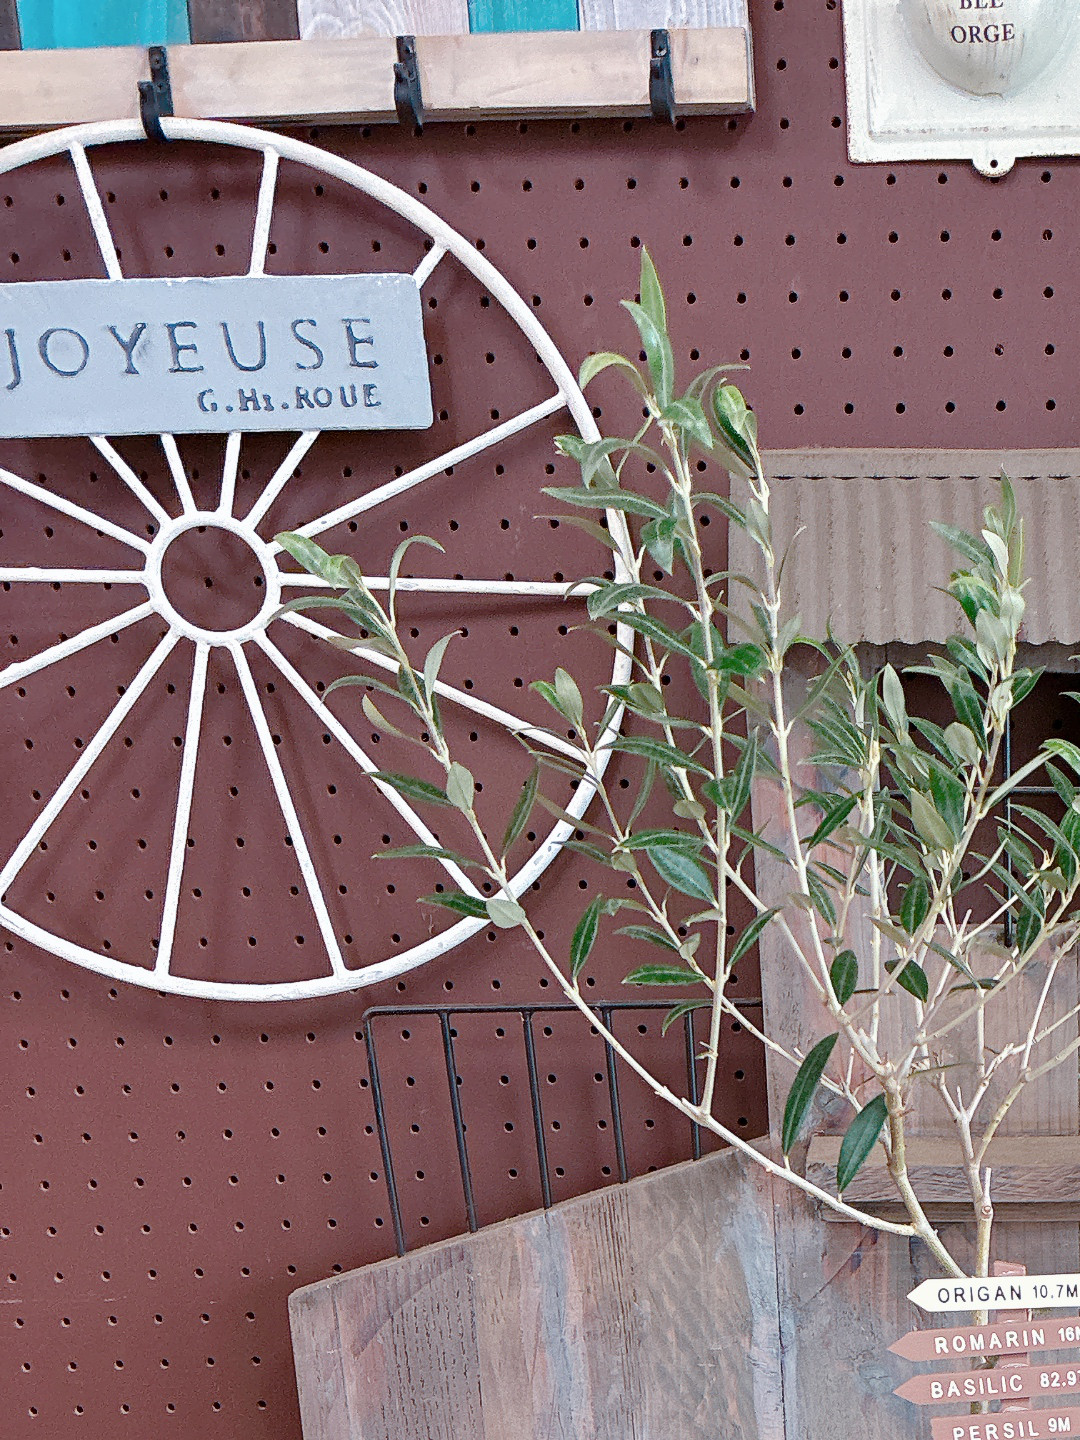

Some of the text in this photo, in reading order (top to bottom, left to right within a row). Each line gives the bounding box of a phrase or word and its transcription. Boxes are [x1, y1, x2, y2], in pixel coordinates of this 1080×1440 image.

[950, 23, 1015, 44] ORGE
[3, 317, 380, 391] JOYEUSE
[937, 1283, 1079, 1303] ORIGAN 10.7M
[933, 1327, 1046, 1354] ROMARIN
[929, 1373, 1023, 1399] BASILIC
[1047, 1416, 1071, 1433] 9M
